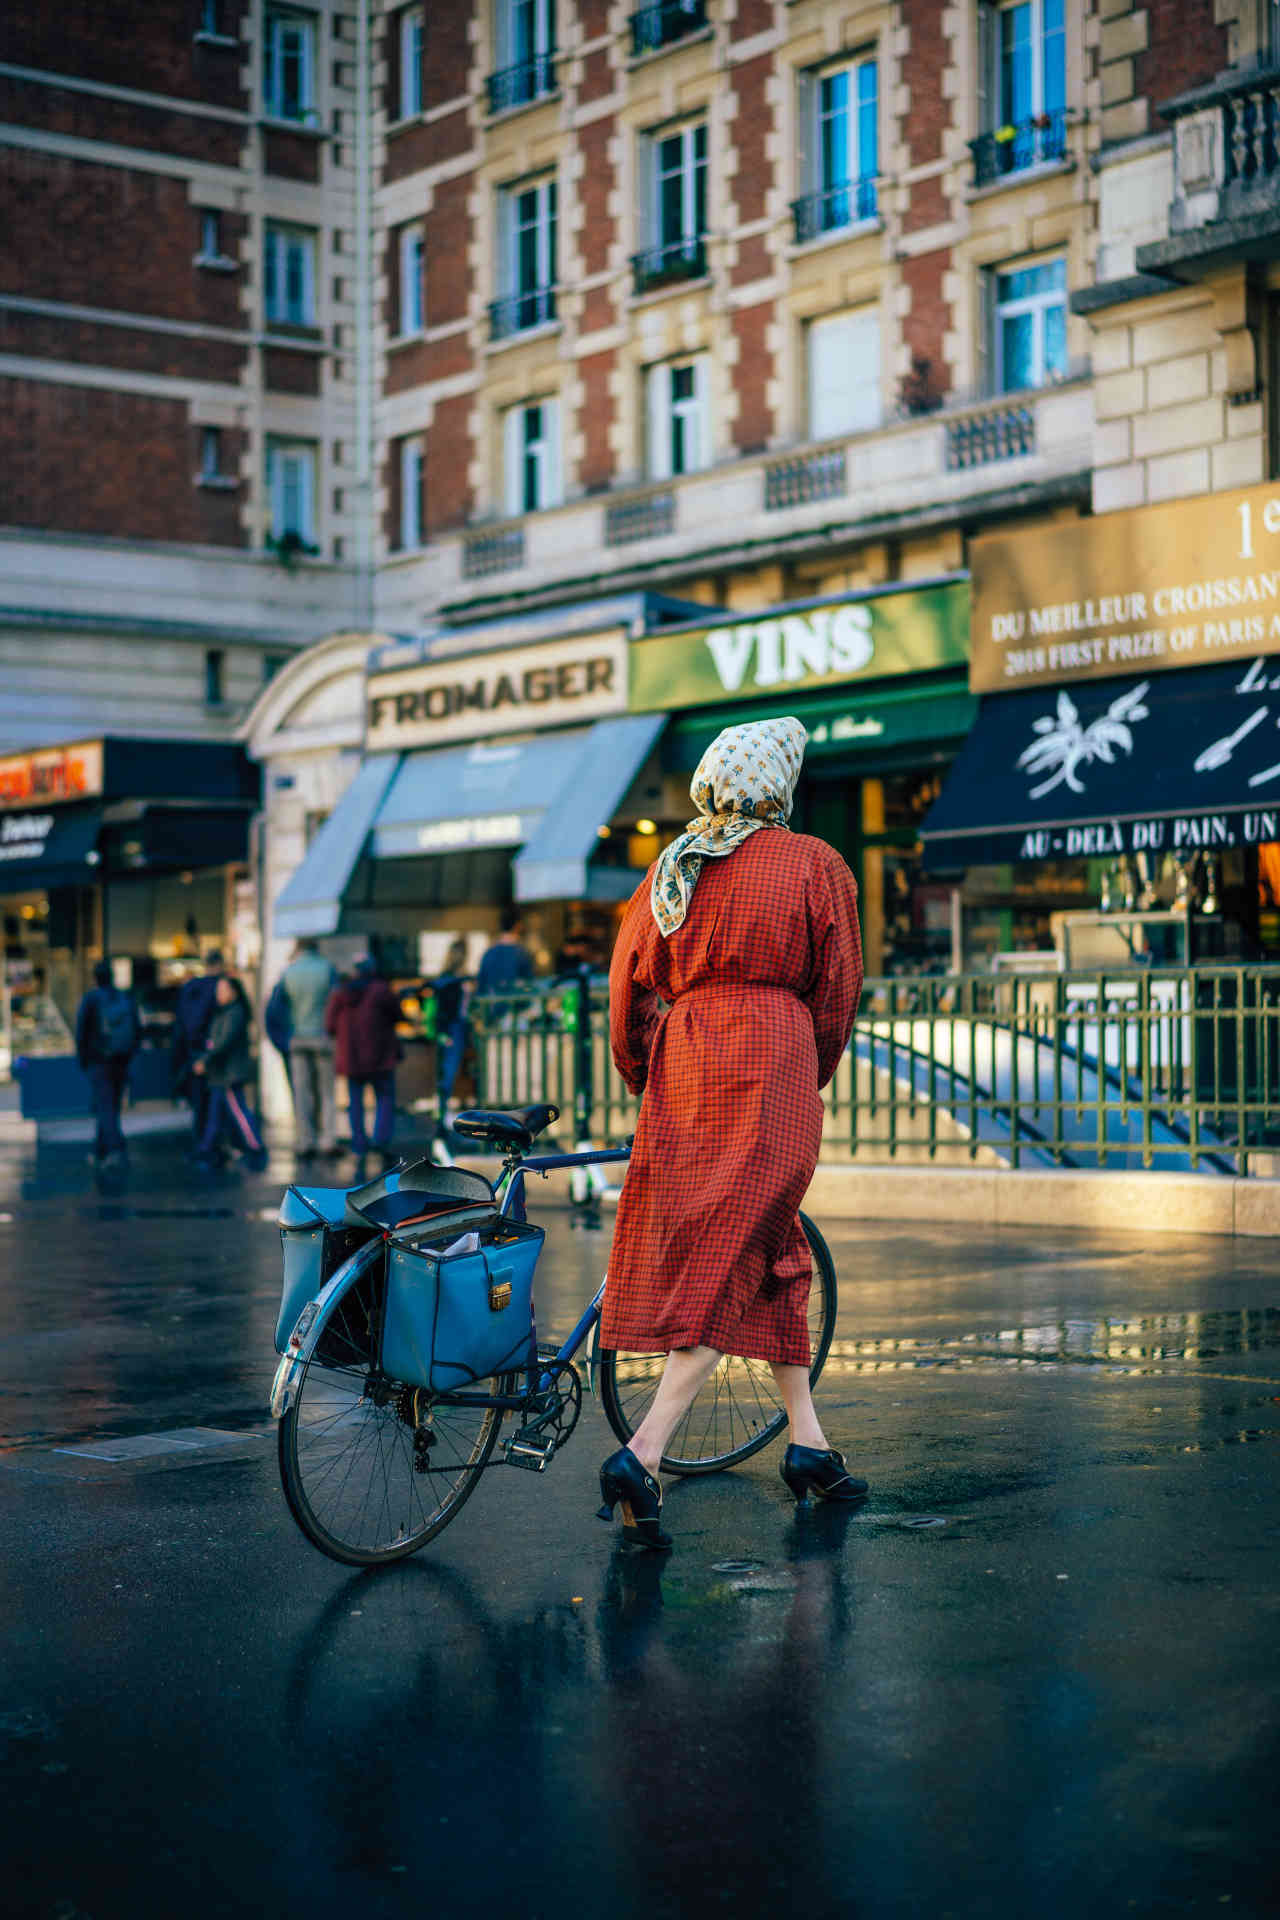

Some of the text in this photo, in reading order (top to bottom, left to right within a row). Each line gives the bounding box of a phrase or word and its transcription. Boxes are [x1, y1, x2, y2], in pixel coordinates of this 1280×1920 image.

[991, 613, 1025, 641] DU
[1030, 593, 1147, 635] MEILLEUR
[1049, 638, 1104, 670] FIRST
[1108, 630, 1166, 661] PRIZE
[1169, 626, 1199, 652] OF
[1203, 615, 1264, 648] PARIS
[706, 605, 873, 690] VINS
[369, 658, 614, 727] FROMAGER
[1132, 821, 1164, 850] DU
[1173, 815, 1236, 847] PAIN,
[1244, 812, 1276, 842] UN
